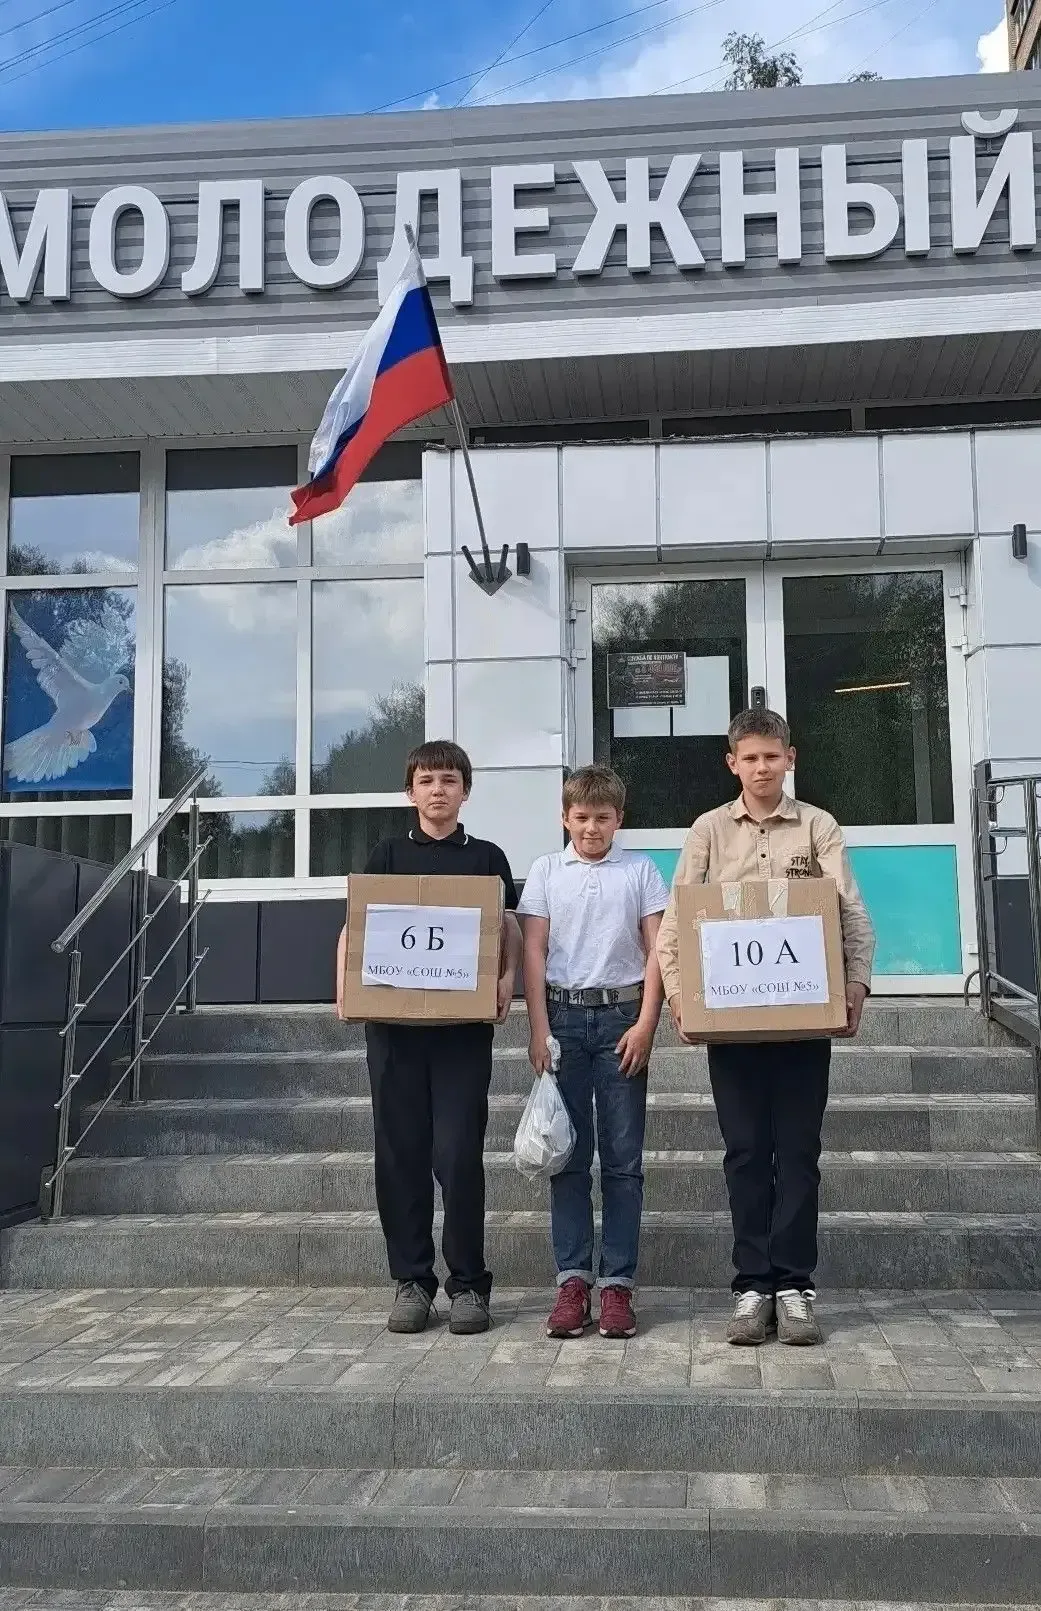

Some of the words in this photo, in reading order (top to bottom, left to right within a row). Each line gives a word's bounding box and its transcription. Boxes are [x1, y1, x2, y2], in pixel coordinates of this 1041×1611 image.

[0, 109, 1037, 306] МОЛОДЕЖНЫЙ
[401, 926, 416, 950] 6
[425, 926, 444, 951] Б
[731, 940, 764, 967] 10
[774, 938, 800, 965] А
[367, 965, 403, 976] МБОУ
[407, 966, 442, 978] «СОШ
[444, 968, 469, 979] №5»
[710, 984, 748, 996] МБОУ
[752, 982, 789, 994] «СОШ
[792, 981, 819, 993] №5»
